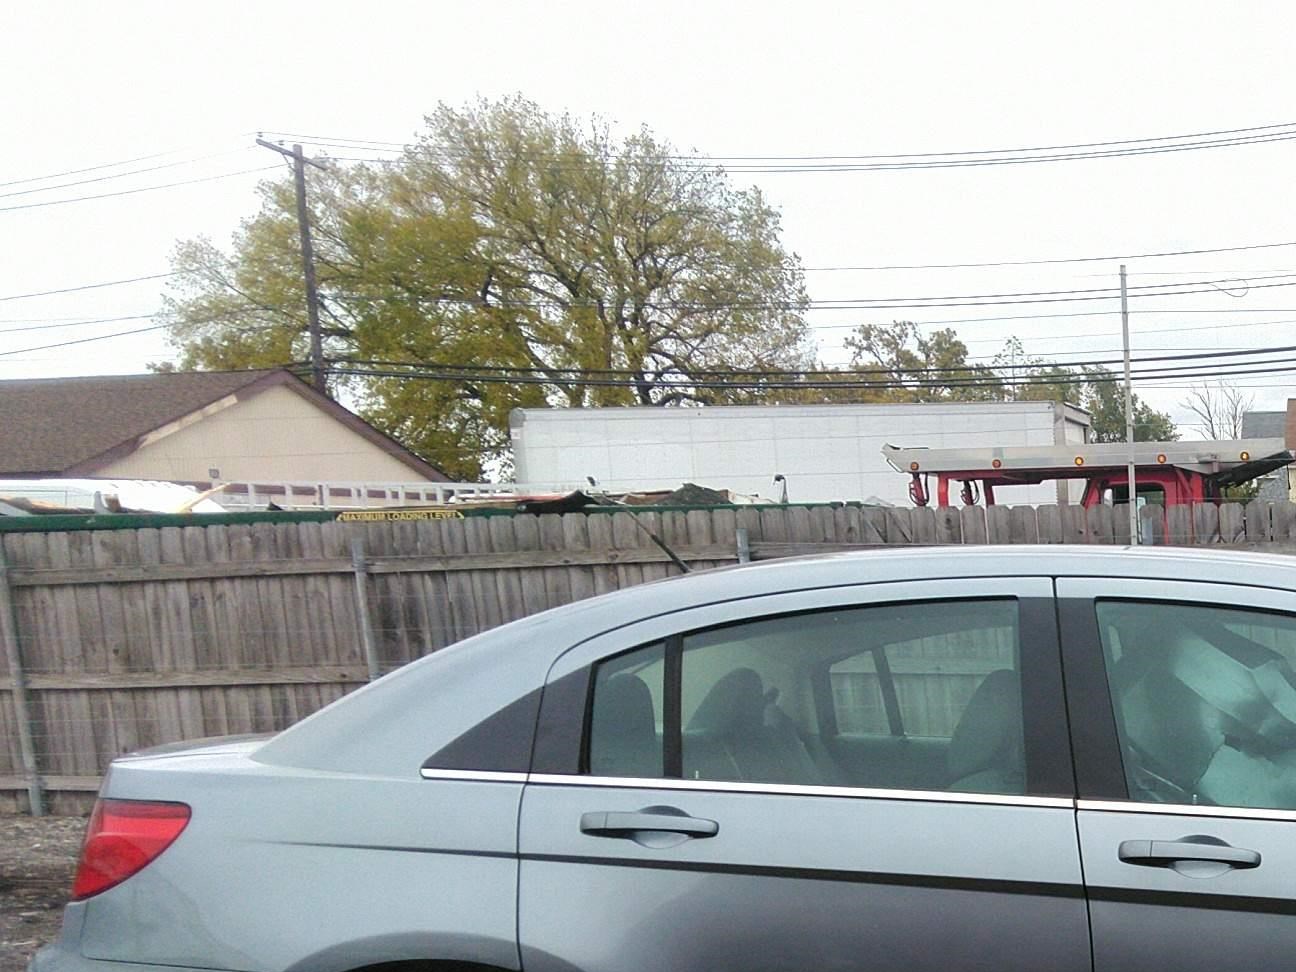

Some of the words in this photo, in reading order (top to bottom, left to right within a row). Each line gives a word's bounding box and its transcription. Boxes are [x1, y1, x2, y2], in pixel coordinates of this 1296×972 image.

[342, 511, 385, 521] MAXIMUM
[387, 511, 428, 521] LOADING
[430, 510, 458, 520] LEVEL
